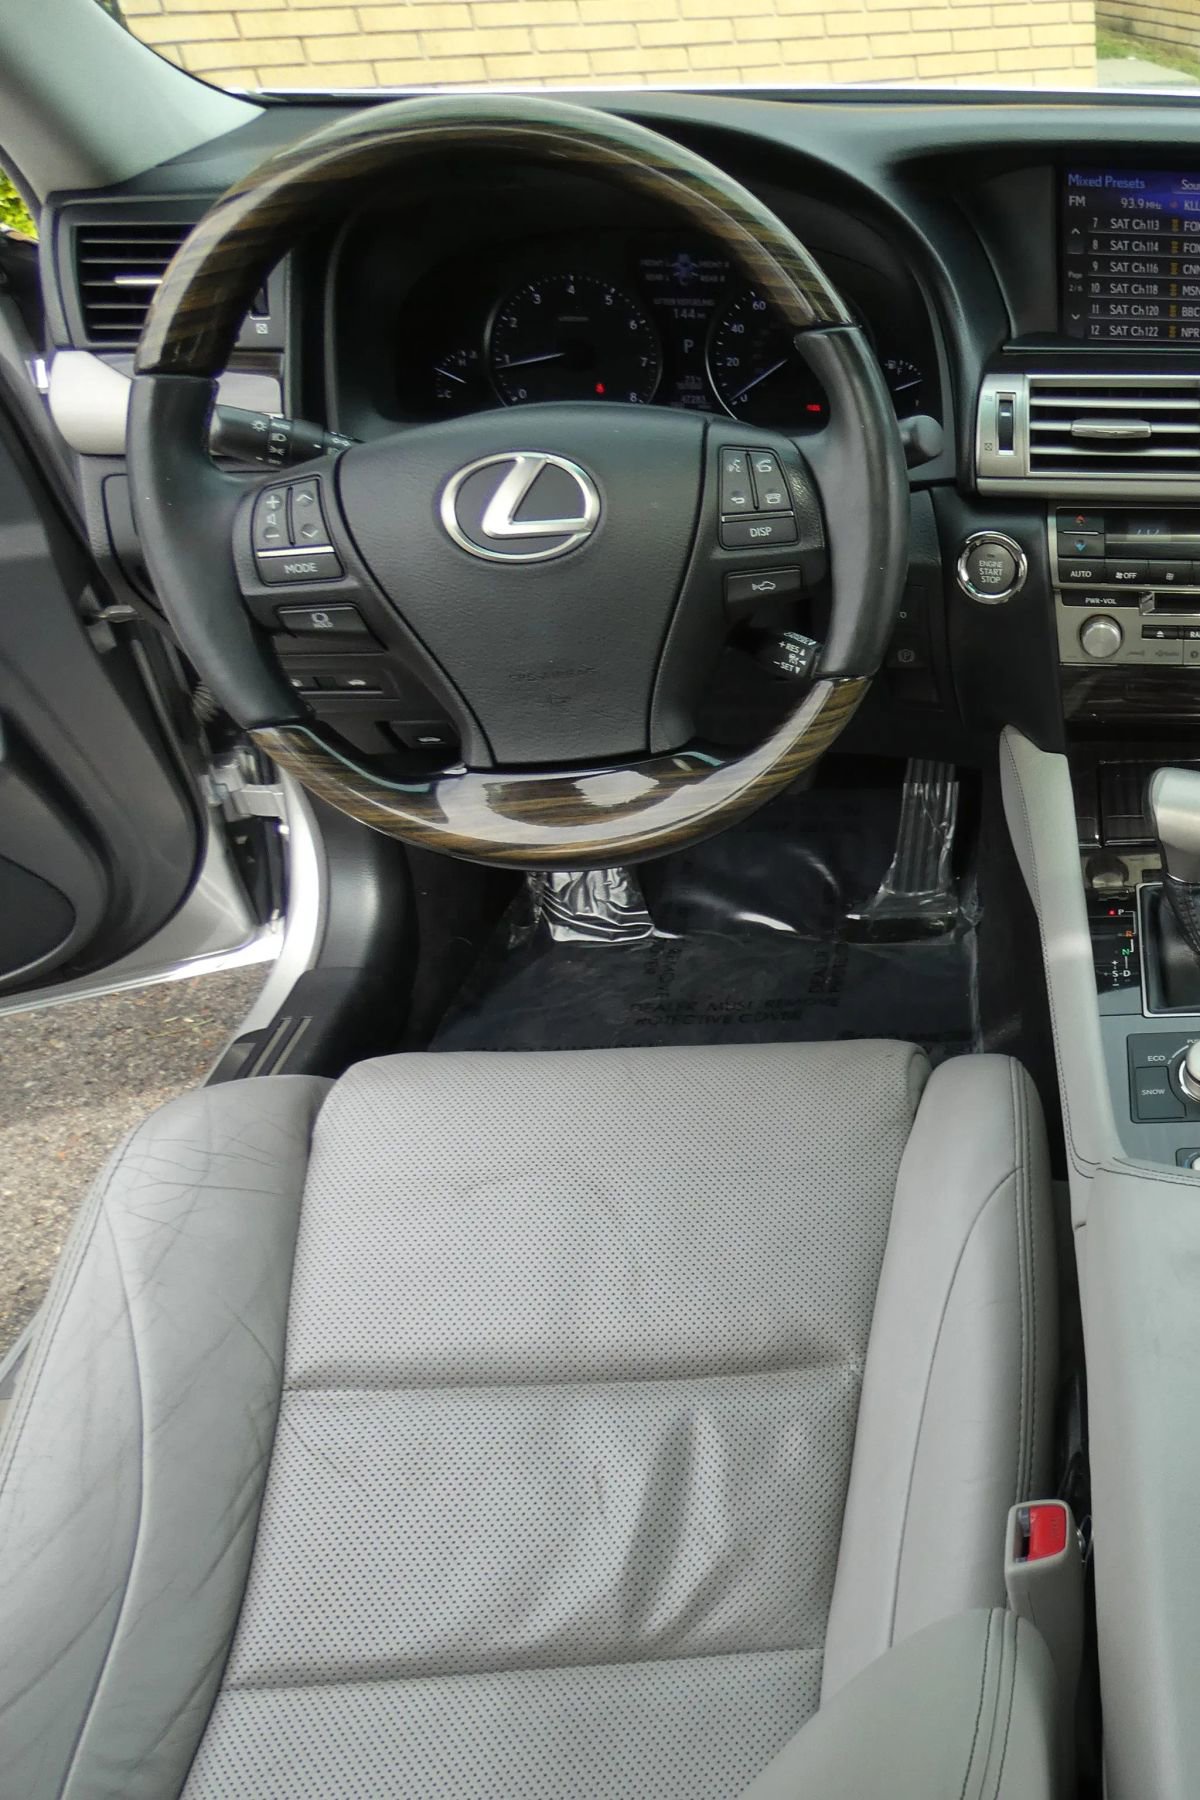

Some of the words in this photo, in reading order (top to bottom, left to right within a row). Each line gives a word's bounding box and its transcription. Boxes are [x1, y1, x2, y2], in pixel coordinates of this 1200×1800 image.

[1068, 174, 1102, 188] Mixed
[1104, 176, 1146, 189] Presets
[1068, 195, 1086, 207] FM
[1120, 197, 1145, 209] 93.9
[1093, 217, 1098, 228] 7
[1110, 218, 1130, 230] SAT
[1132, 219, 1160, 231] Ch113
[1092, 239, 1099, 250] 8
[1110, 240, 1130, 251] SAT
[1131, 241, 1159, 252] Ch114
[1092, 261, 1099, 272] 9
[1110, 262, 1130, 273] SAT
[1091, 282, 1101, 293] 10
[1110, 283, 1129, 294] SAT
[533, 294, 542, 305] 3
[604, 294, 614, 306] 5
[752, 300, 767, 311] 60
[1092, 304, 1099, 314] 11
[1109, 304, 1129, 315] SAT
[1181, 307, 1200, 317] BBC
[630, 319, 638, 330] 6
[731, 323, 745, 335] 40
[1091, 325, 1100, 336] 12
[1109, 326, 1129, 337] SAT
[1181, 328, 1200, 339] NPR
[683, 338, 694, 353] P
[640, 356, 648, 368] 7
[726, 356, 740, 368] 20
[630, 392, 638, 403] 8
[749, 526, 773, 538] DISP
[284, 563, 319, 575] MODE
[979, 568, 1003, 576] START
[1070, 570, 1092, 578] AUTO
[981, 576, 1001, 584] STOP
[1123, 572, 1137, 580] OFF
[1117, 908, 1125, 916] P
[1121, 948, 1130, 956] N
[1111, 970, 1119, 978] S
[1122, 970, 1131, 978] D
[1141, 1088, 1166, 1096] SNOW
